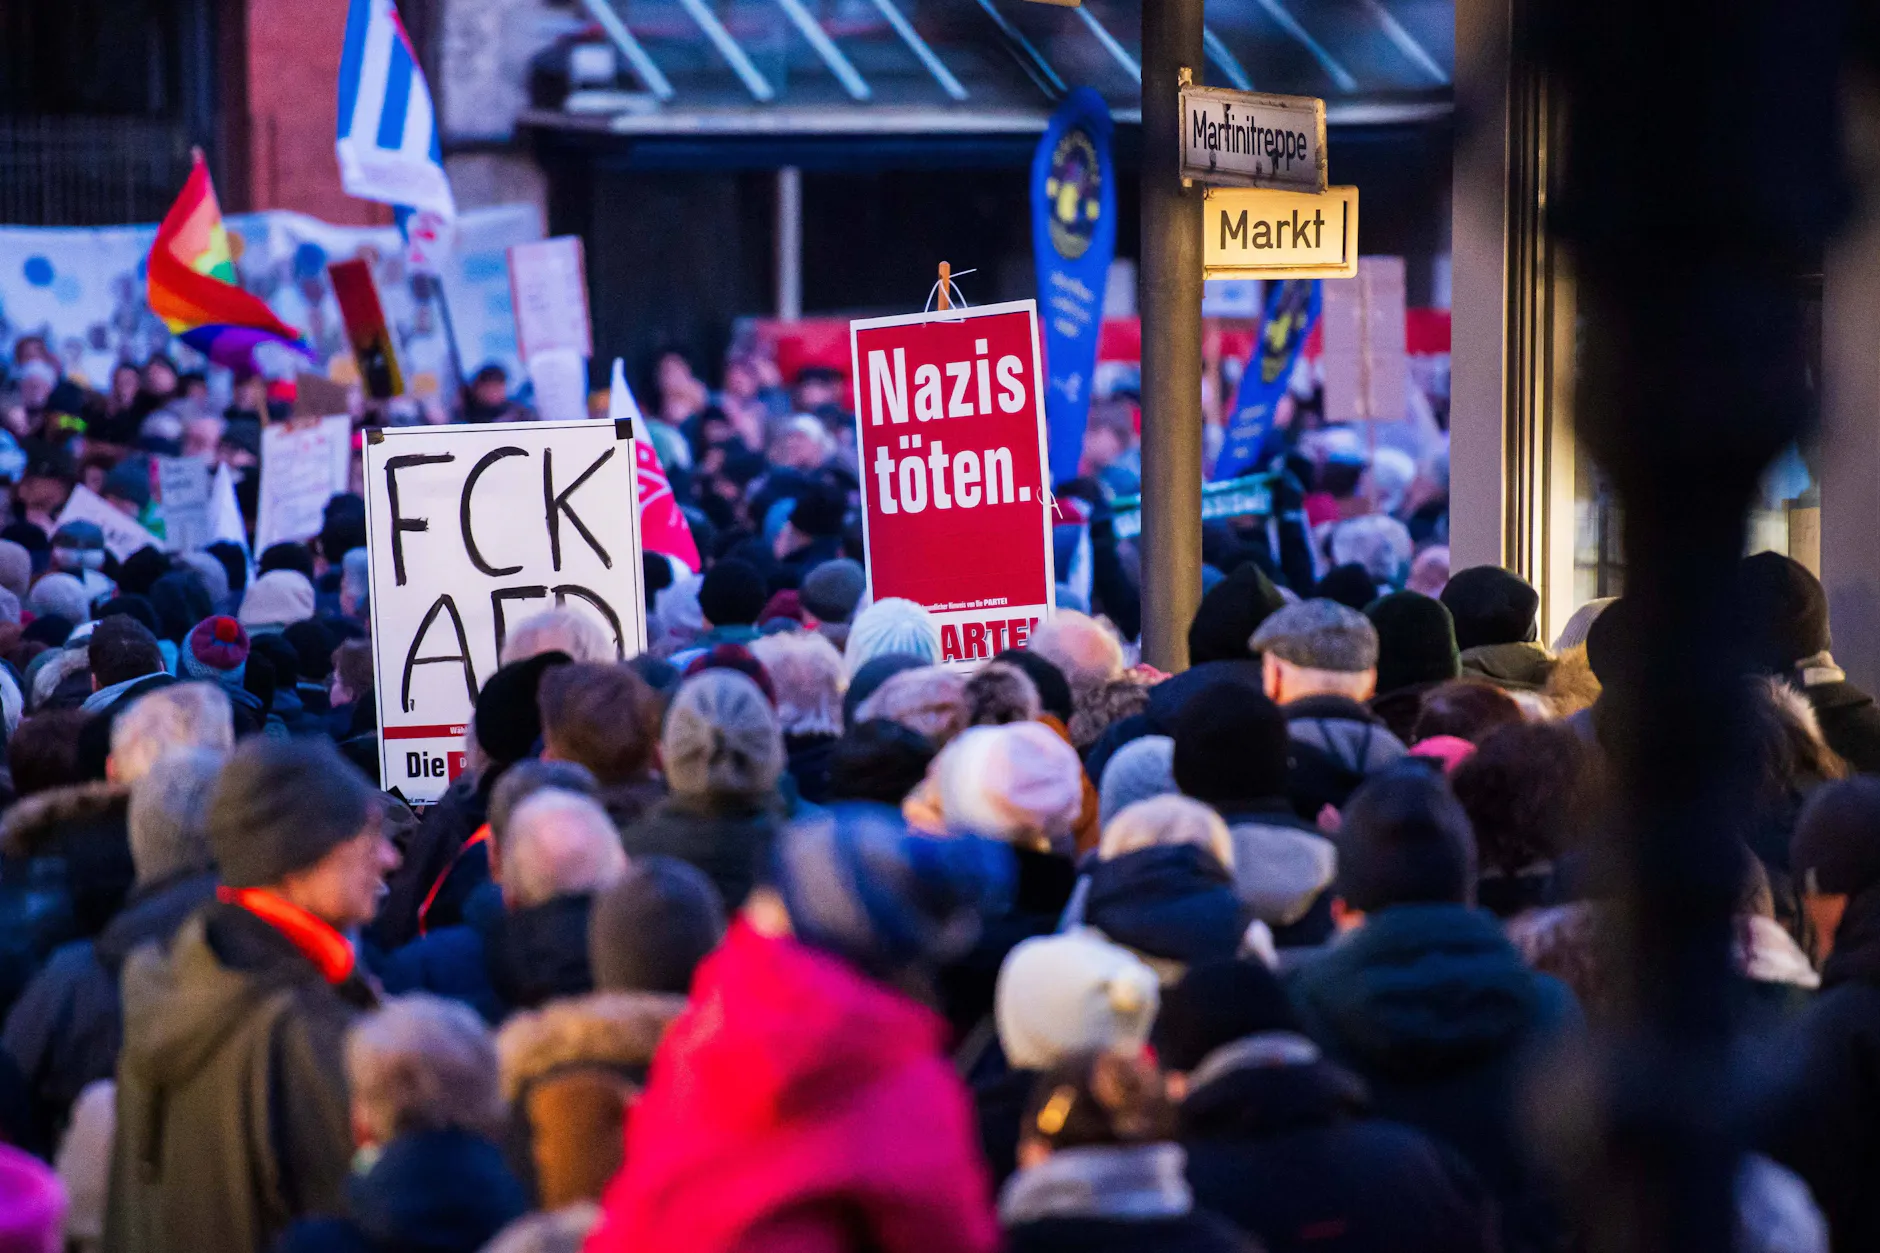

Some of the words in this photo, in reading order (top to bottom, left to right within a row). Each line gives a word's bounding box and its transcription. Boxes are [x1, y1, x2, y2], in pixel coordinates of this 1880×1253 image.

[1193, 110, 1307, 171] Martinitreppe
[1220, 209, 1325, 250] Markt
[867, 338, 1026, 426] Nazis
[874, 434, 1031, 515] töten.
[383, 446, 615, 586] FCK
[983, 597, 1008, 607] PARTEI
[941, 617, 1039, 661] ARTE
[406, 751, 445, 778] Die
